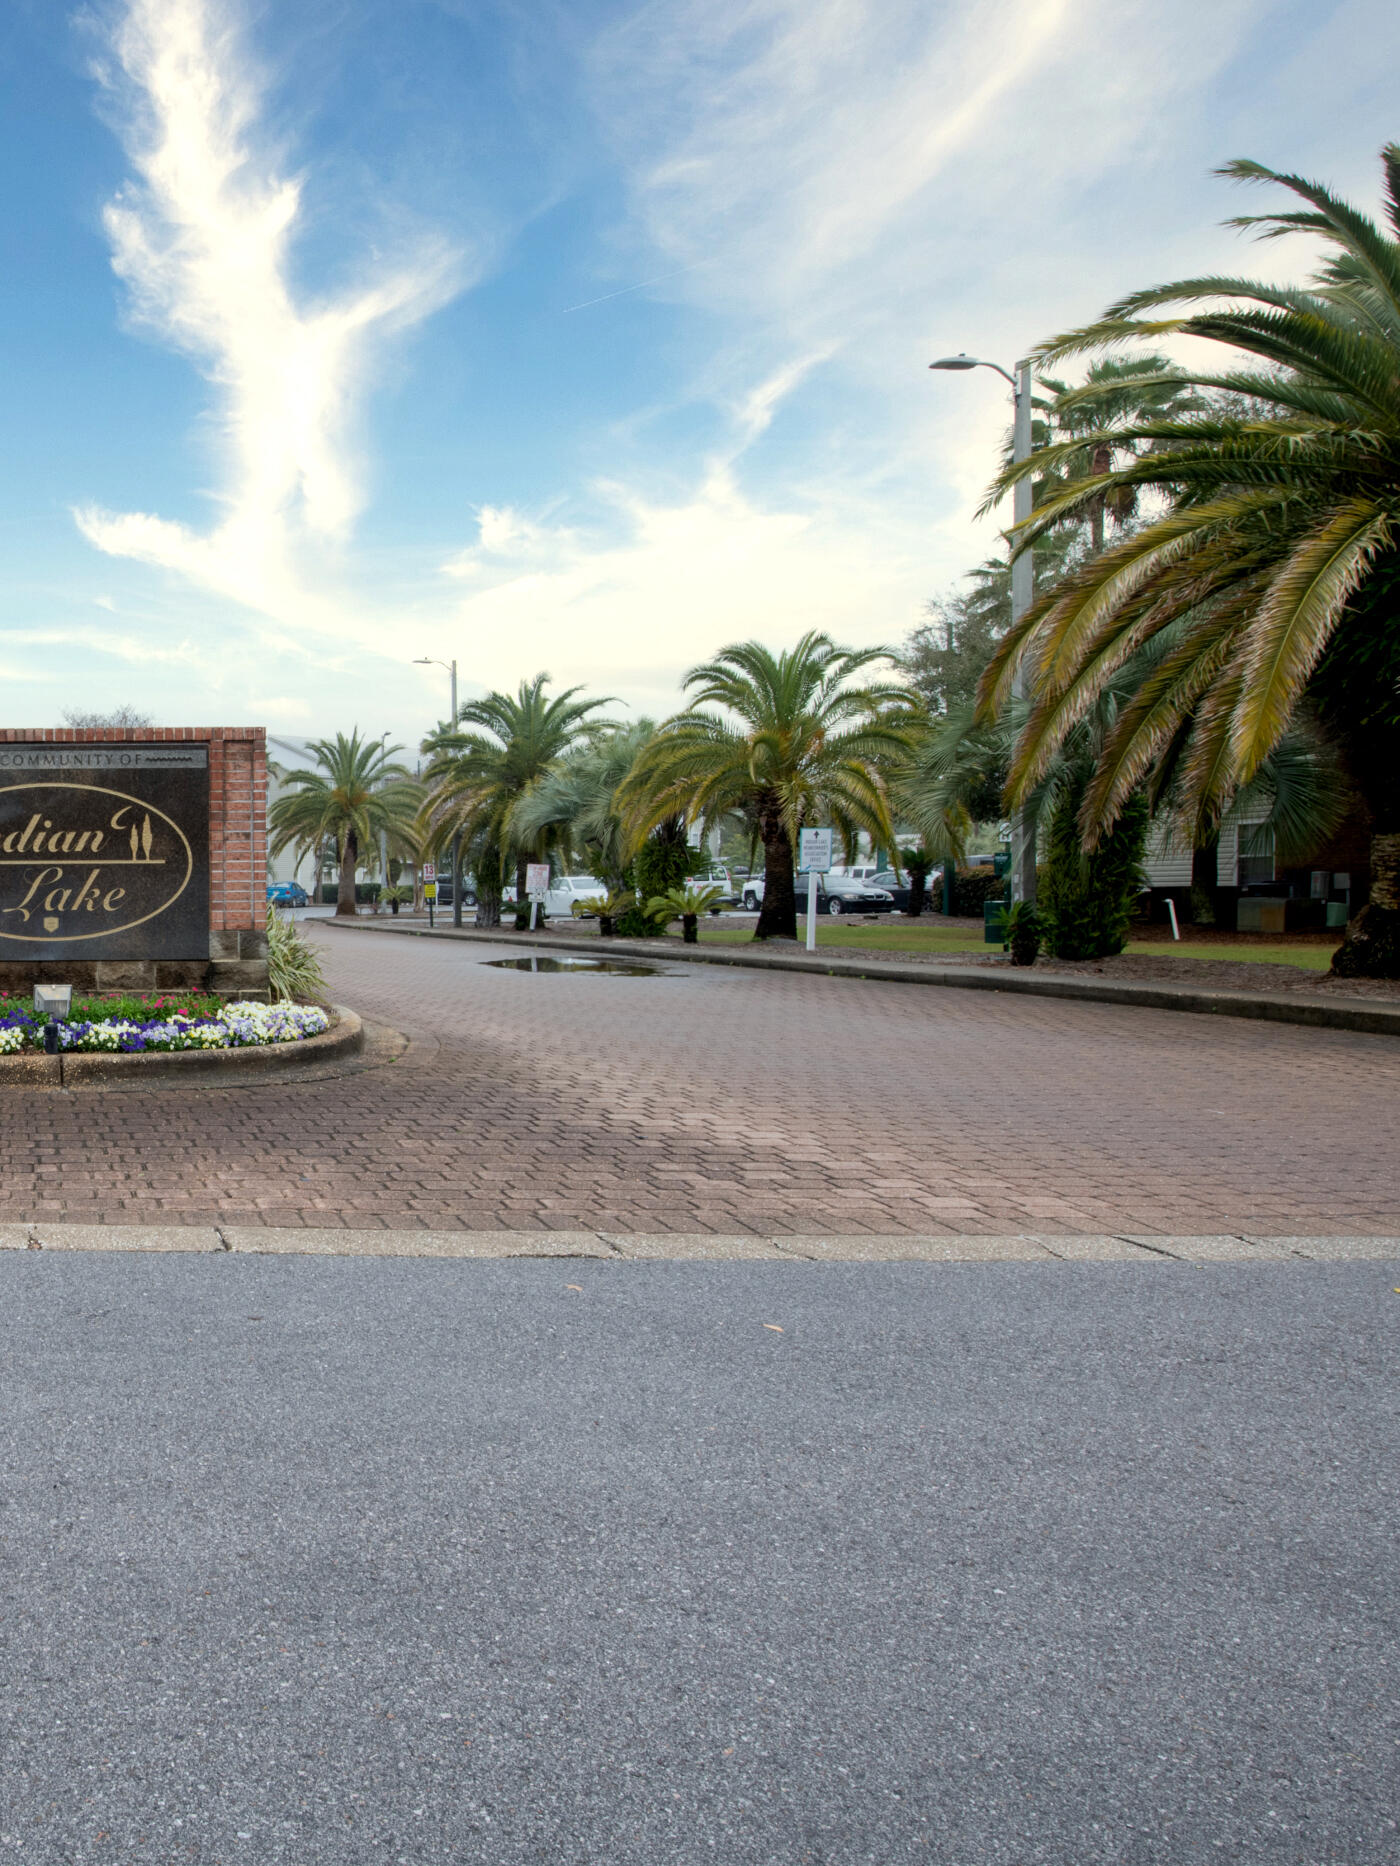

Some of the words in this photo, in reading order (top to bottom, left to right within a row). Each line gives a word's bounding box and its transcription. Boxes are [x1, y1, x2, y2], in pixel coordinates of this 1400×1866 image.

[0, 754, 113, 767] COMMUNITY
[120, 753, 142, 766] OF
[425, 865, 434, 875] 13
[2, 866, 127, 922] Lake
